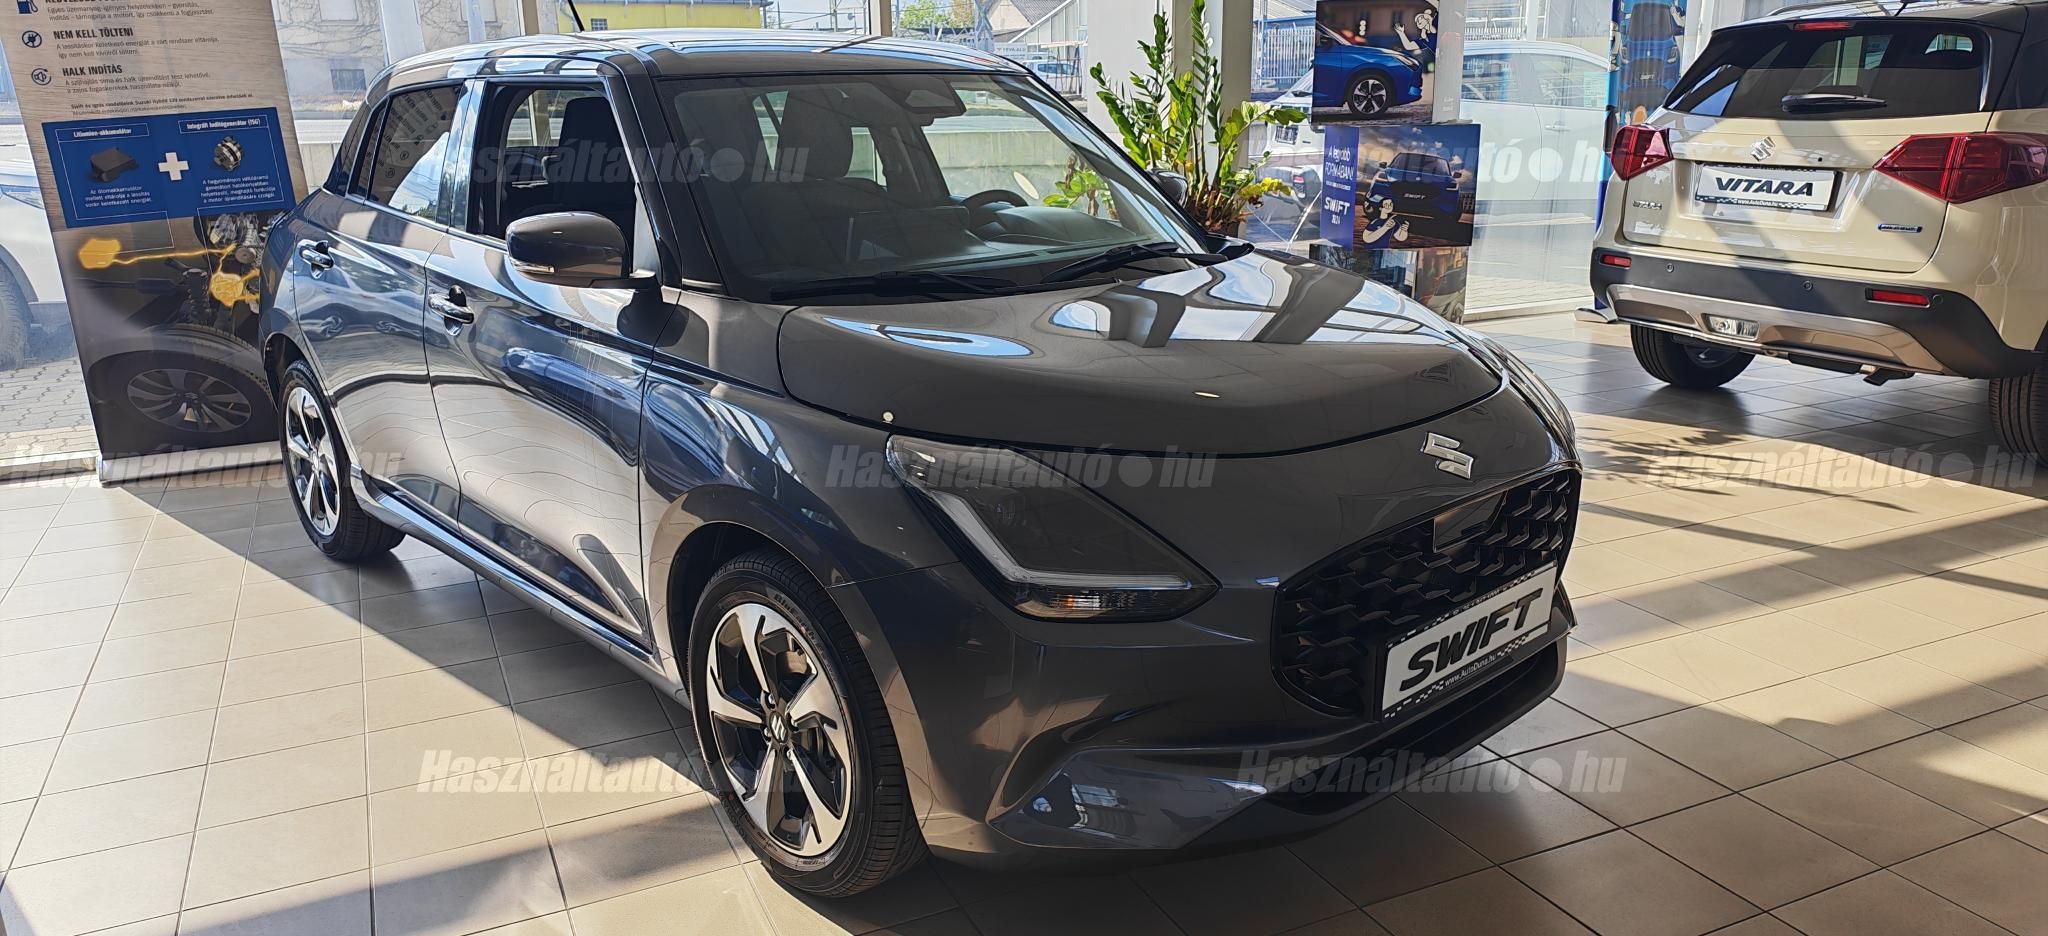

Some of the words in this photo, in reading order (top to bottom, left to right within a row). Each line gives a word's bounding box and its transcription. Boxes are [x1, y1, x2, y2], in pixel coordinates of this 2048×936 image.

[53, 30, 74, 40] NEM
[75, 29, 98, 38] KELL
[98, 26, 134, 38] TÖLTENI
[62, 67, 86, 76] HALK
[88, 64, 122, 75] INDÍTÁS
[1328, 146, 1333, 158] A
[1715, 177, 1814, 197] VITARA
[1324, 196, 1350, 216] SWIFT
[1400, 588, 1544, 692] SWIFT
[1444, 653, 1497, 686] www.AutoDuna.hu
